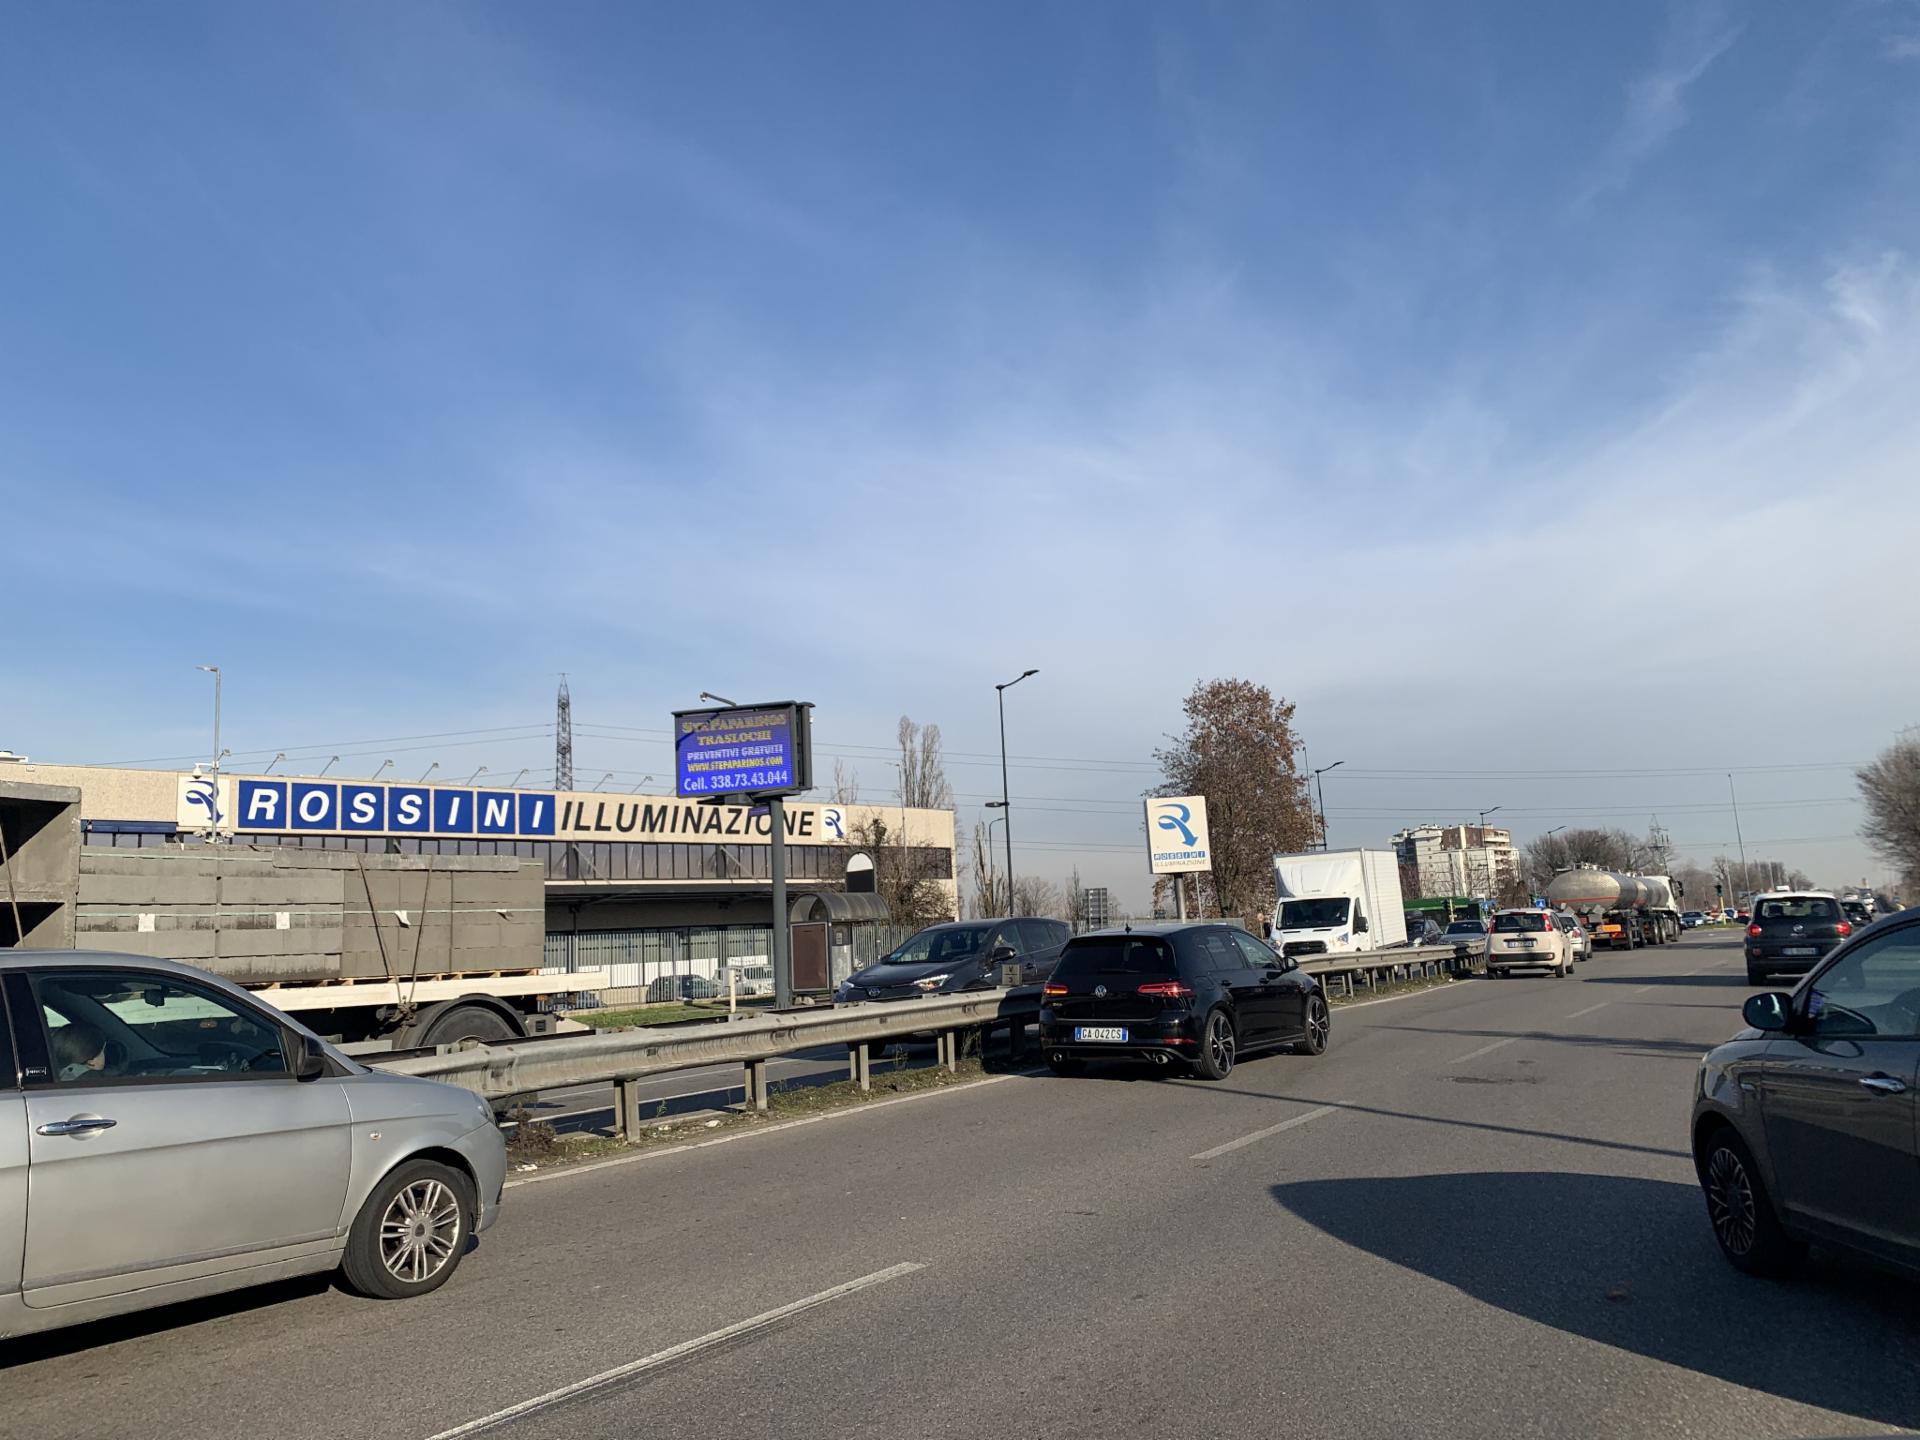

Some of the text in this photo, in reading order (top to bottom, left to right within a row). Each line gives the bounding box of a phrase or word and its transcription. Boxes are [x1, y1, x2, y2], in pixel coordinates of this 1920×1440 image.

[687, 747, 739, 761] PREVENTIVI
[684, 770, 788, 791] Cell. 338.73.43.044
[247, 788, 544, 828] ROSSINI
